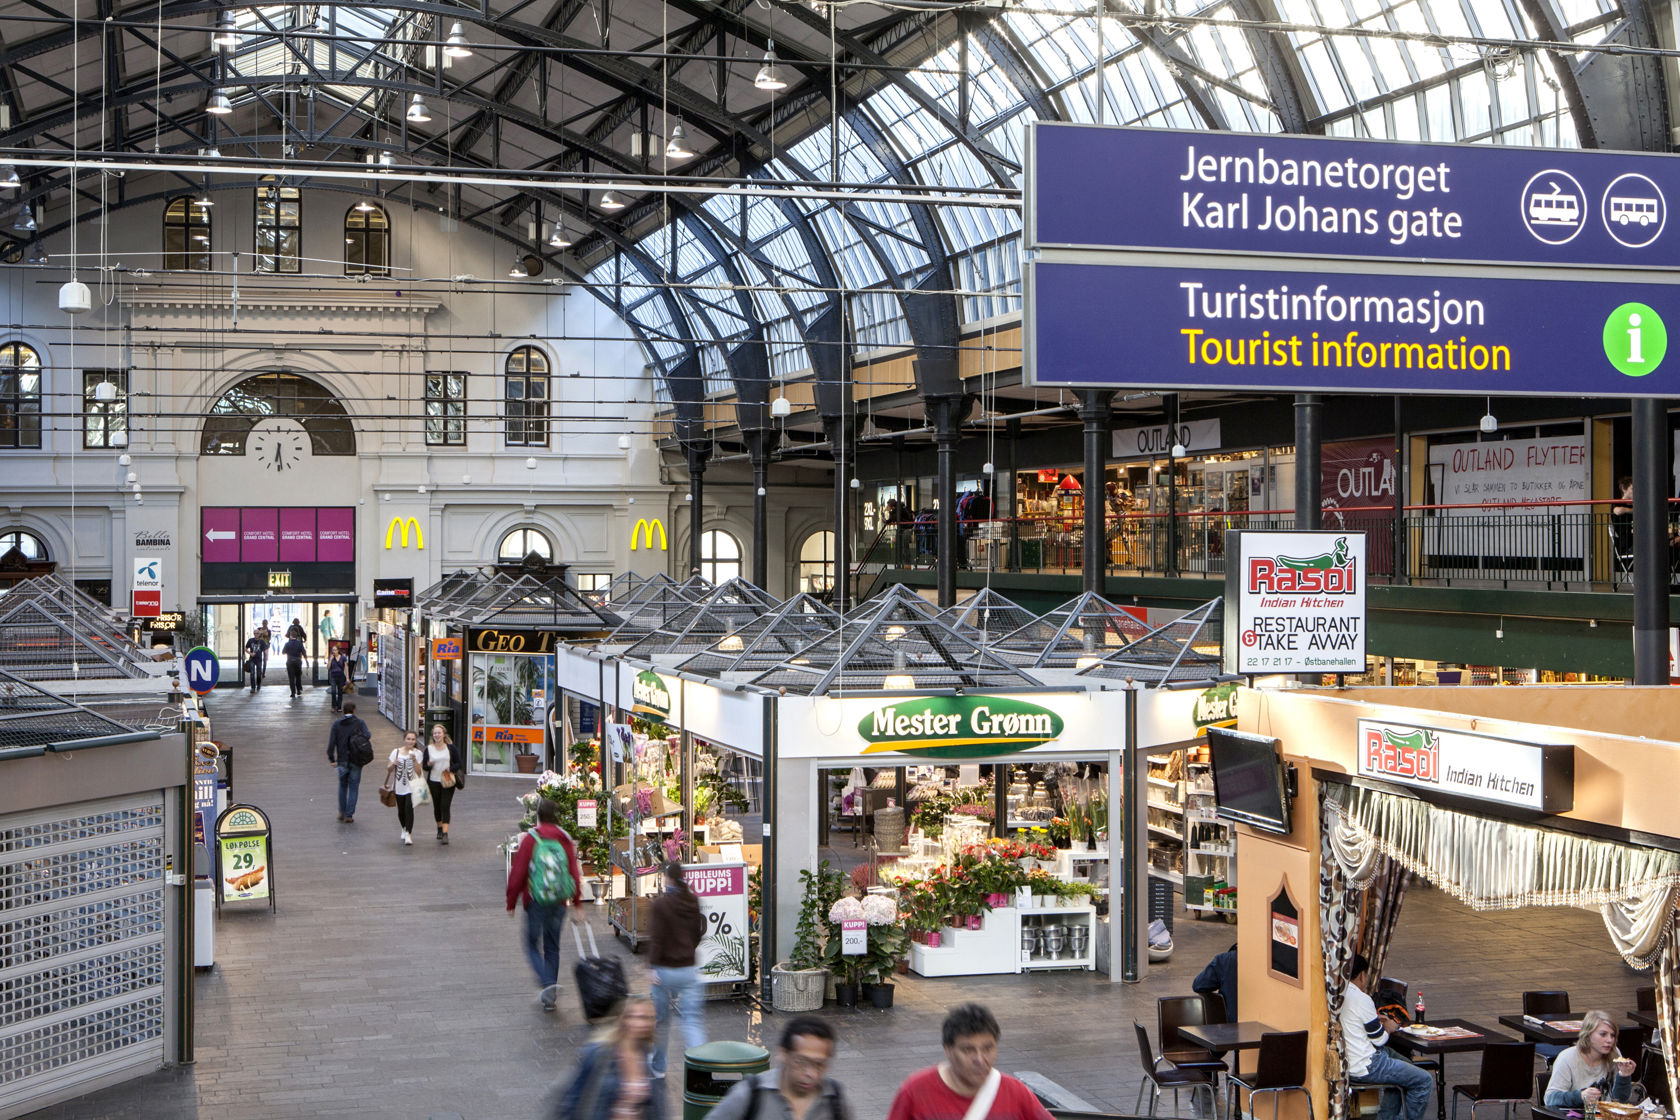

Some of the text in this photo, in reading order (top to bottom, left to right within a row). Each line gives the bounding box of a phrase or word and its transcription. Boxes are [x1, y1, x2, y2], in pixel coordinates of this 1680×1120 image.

[1179, 146, 1451, 200] Jernbanetorget
[1182, 192, 1463, 245] Karl Johans gate
[1179, 282, 1485, 333] Turistinformasjon
[1180, 328, 1511, 371] Tourist information
[1452, 447, 1515, 474] OUTLAND
[1510, 482, 1518, 491] TO
[1522, 480, 1553, 490] BUTIKKER
[135, 538, 171, 546] BAMBINA
[269, 574, 290, 587] EXIT
[1249, 557, 1356, 594] Rasoi
[1260, 597, 1344, 608] Indian Kitchen
[1253, 617, 1360, 632] RESTAURANT
[437, 641, 460, 653] Ria
[476, 630, 525, 652] GEO
[1256, 633, 1298, 650] TAKE
[1308, 633, 1358, 650] AWAY
[190, 660, 212, 682] N
[1247, 658, 1258, 666] 22
[1262, 658, 1269, 666] 17
[1273, 657, 1281, 666] 21
[1285, 657, 1293, 666] 17
[1304, 657, 1357, 666] Østbanehallen
[1196, 694, 1229, 721] Mester
[872, 706, 1052, 736] Mester Grønn
[495, 730, 513, 741] Ria
[1366, 729, 1440, 783] Rasoi
[1446, 765, 1534, 797] Indian Kitchen
[683, 869, 732, 880] JUBILEUMS
[843, 921, 866, 929] KUPP!
